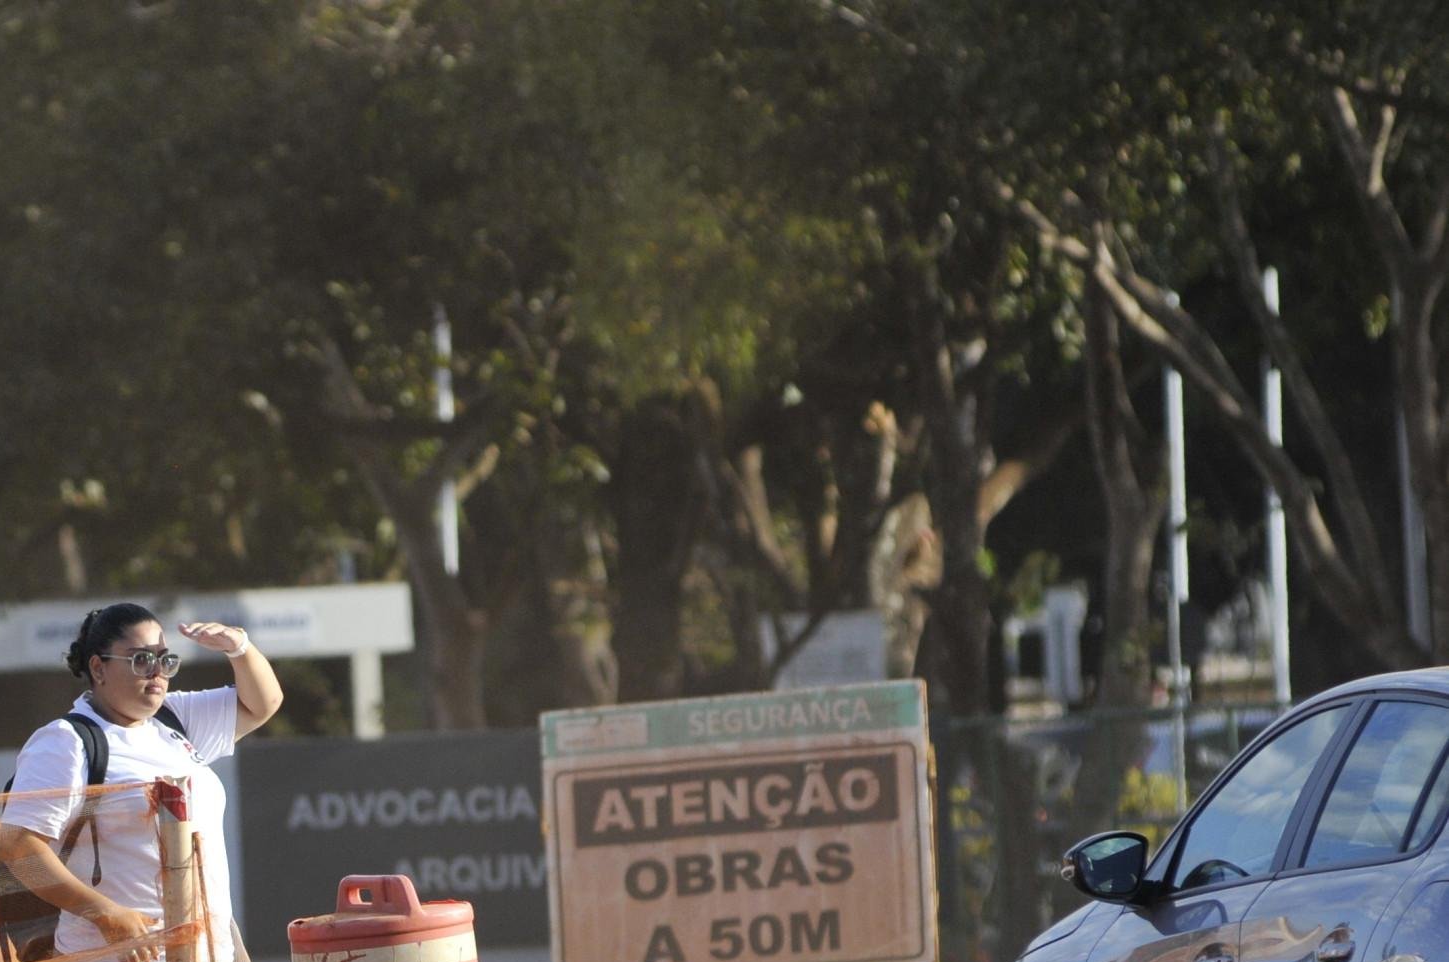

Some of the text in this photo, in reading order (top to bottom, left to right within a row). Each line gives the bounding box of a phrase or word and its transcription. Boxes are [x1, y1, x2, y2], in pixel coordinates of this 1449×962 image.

[687, 697, 872, 738] SEGURANÇA
[287, 784, 538, 832] ADVOCACIA
[592, 761, 881, 834] ATENÇÃO
[623, 841, 856, 901] OBRAS
[708, 908, 842, 961] 50M
